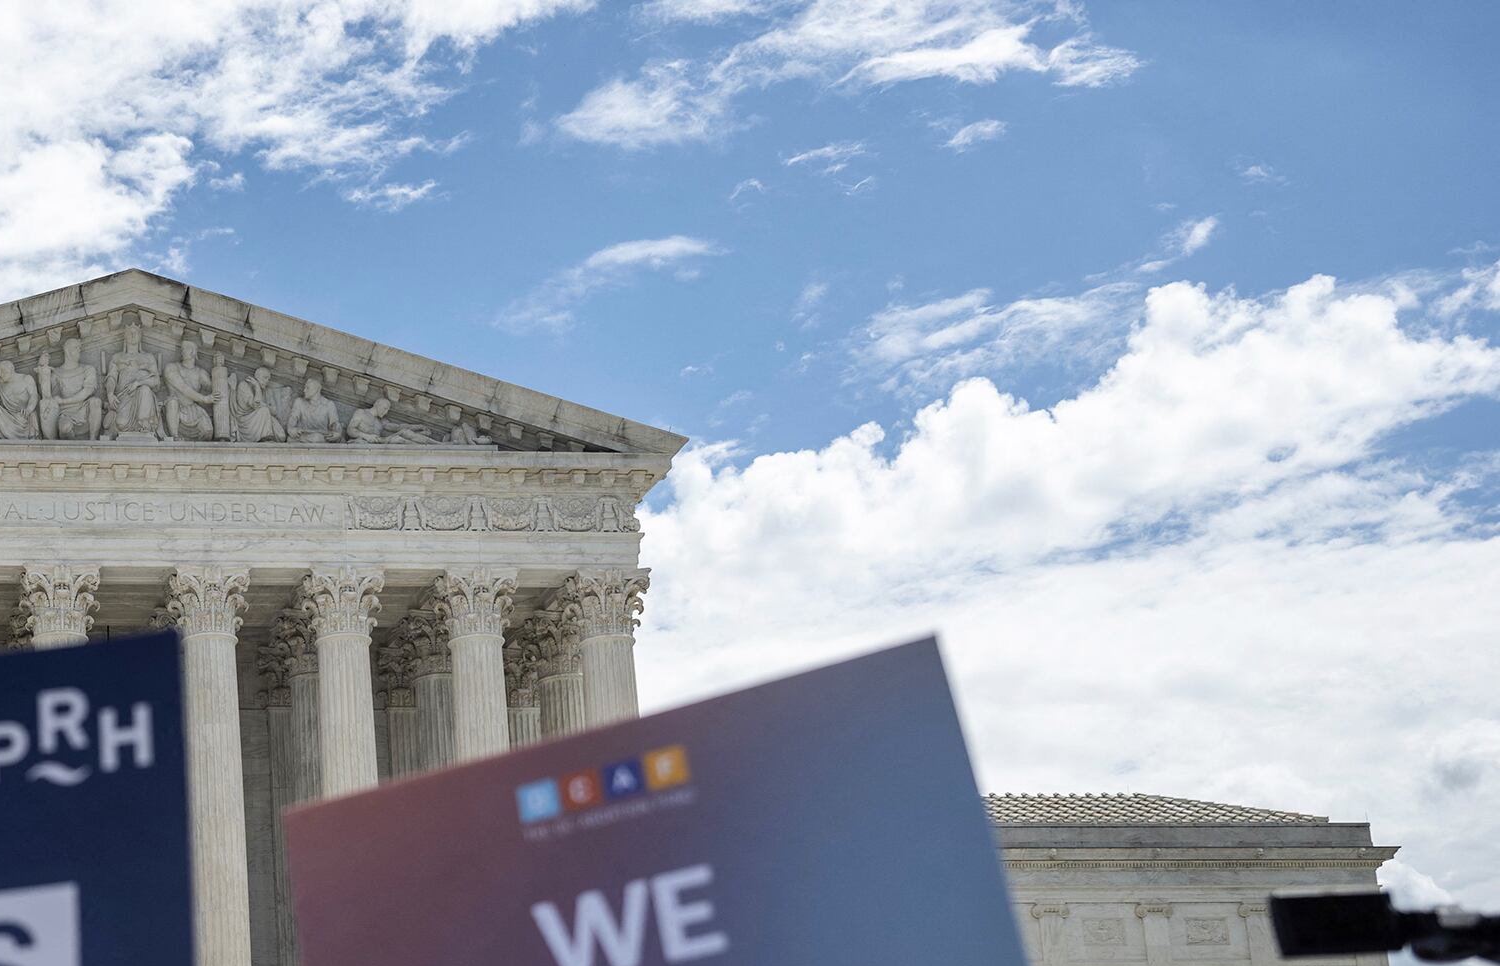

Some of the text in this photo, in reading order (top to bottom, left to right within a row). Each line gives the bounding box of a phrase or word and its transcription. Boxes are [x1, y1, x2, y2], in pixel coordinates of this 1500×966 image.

[44, 501, 155, 522] JUSTICE
[169, 502, 261, 522] UNDER
[273, 503, 326, 523] LAW
